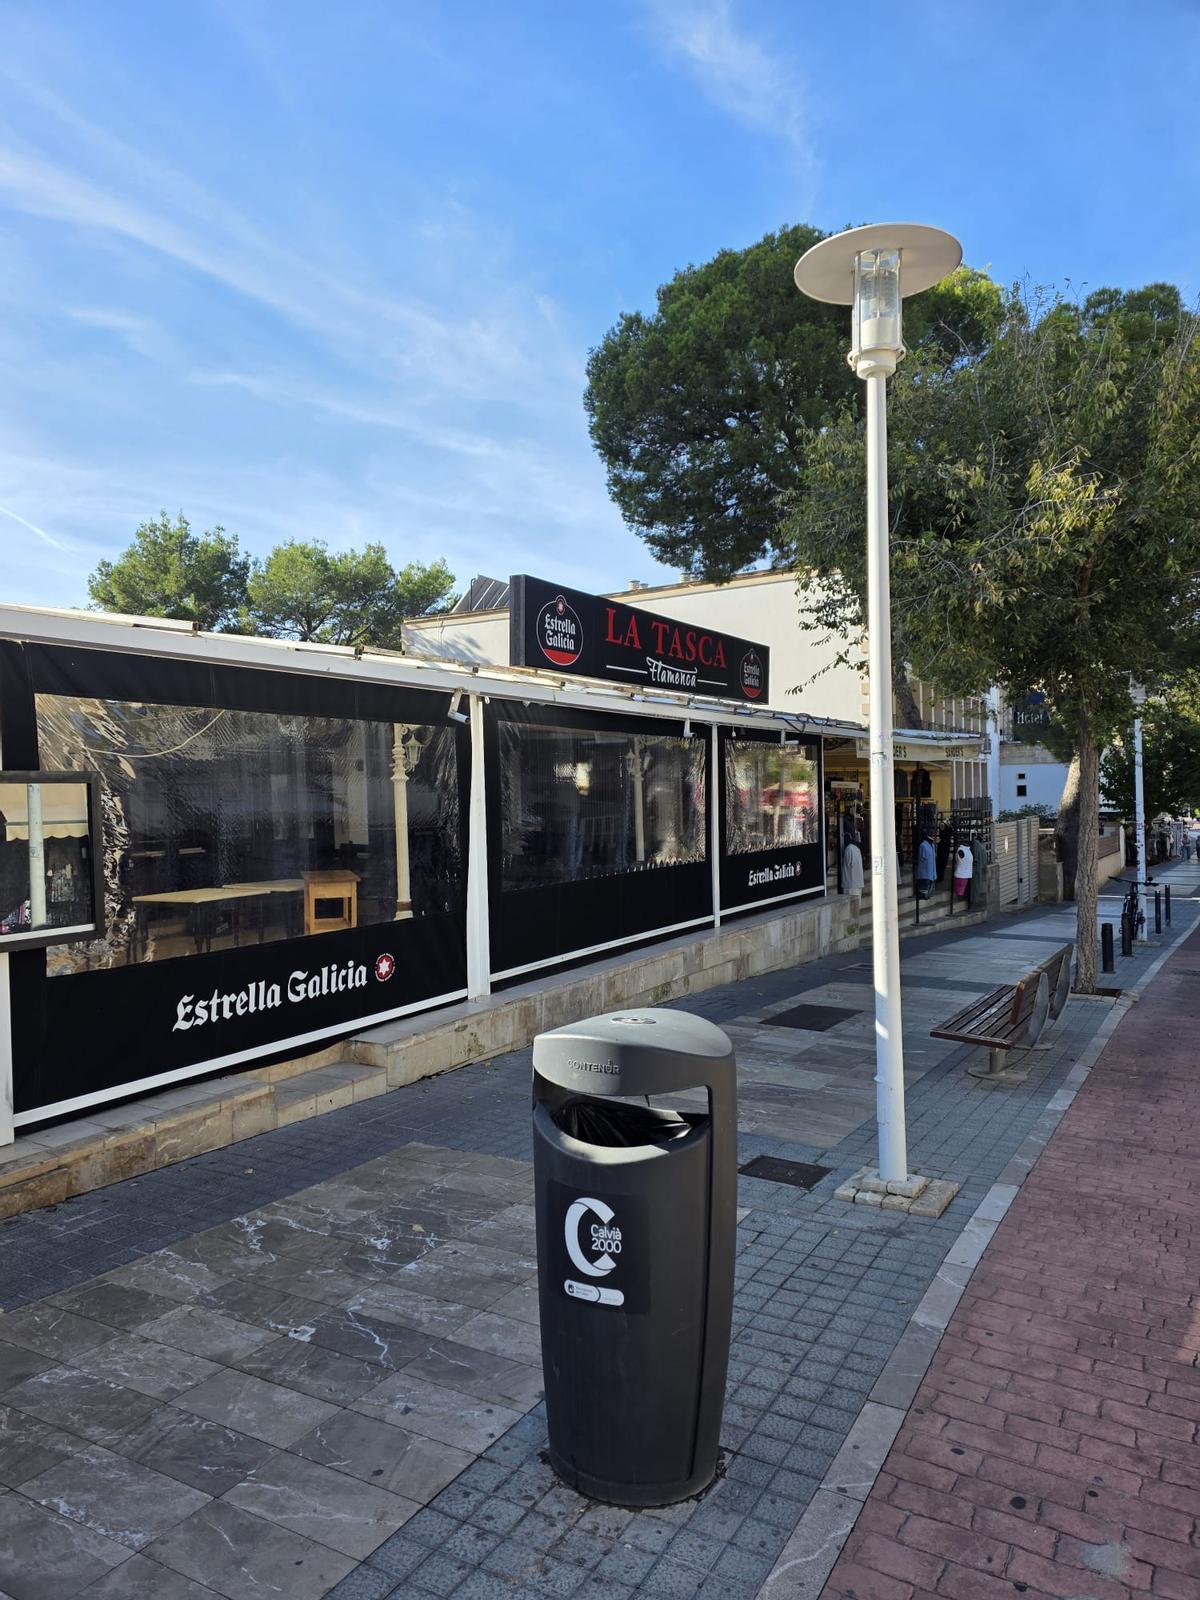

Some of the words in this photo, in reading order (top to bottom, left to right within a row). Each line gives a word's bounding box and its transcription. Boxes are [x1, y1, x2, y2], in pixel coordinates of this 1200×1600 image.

[544, 614, 576, 635] Estrella
[545, 630, 575, 651] Galicia
[604, 607, 642, 650] LA
[651, 619, 728, 669] TASCA
[646, 657, 698, 688] Flamenca
[747, 867, 774, 887] Estrella
[774, 862, 795, 880] Galicia
[172, 980, 282, 1032] Estrella
[287, 960, 368, 1003] Galicia
[590, 1223, 622, 1240] Calvià
[591, 1237, 622, 1254] 2000
